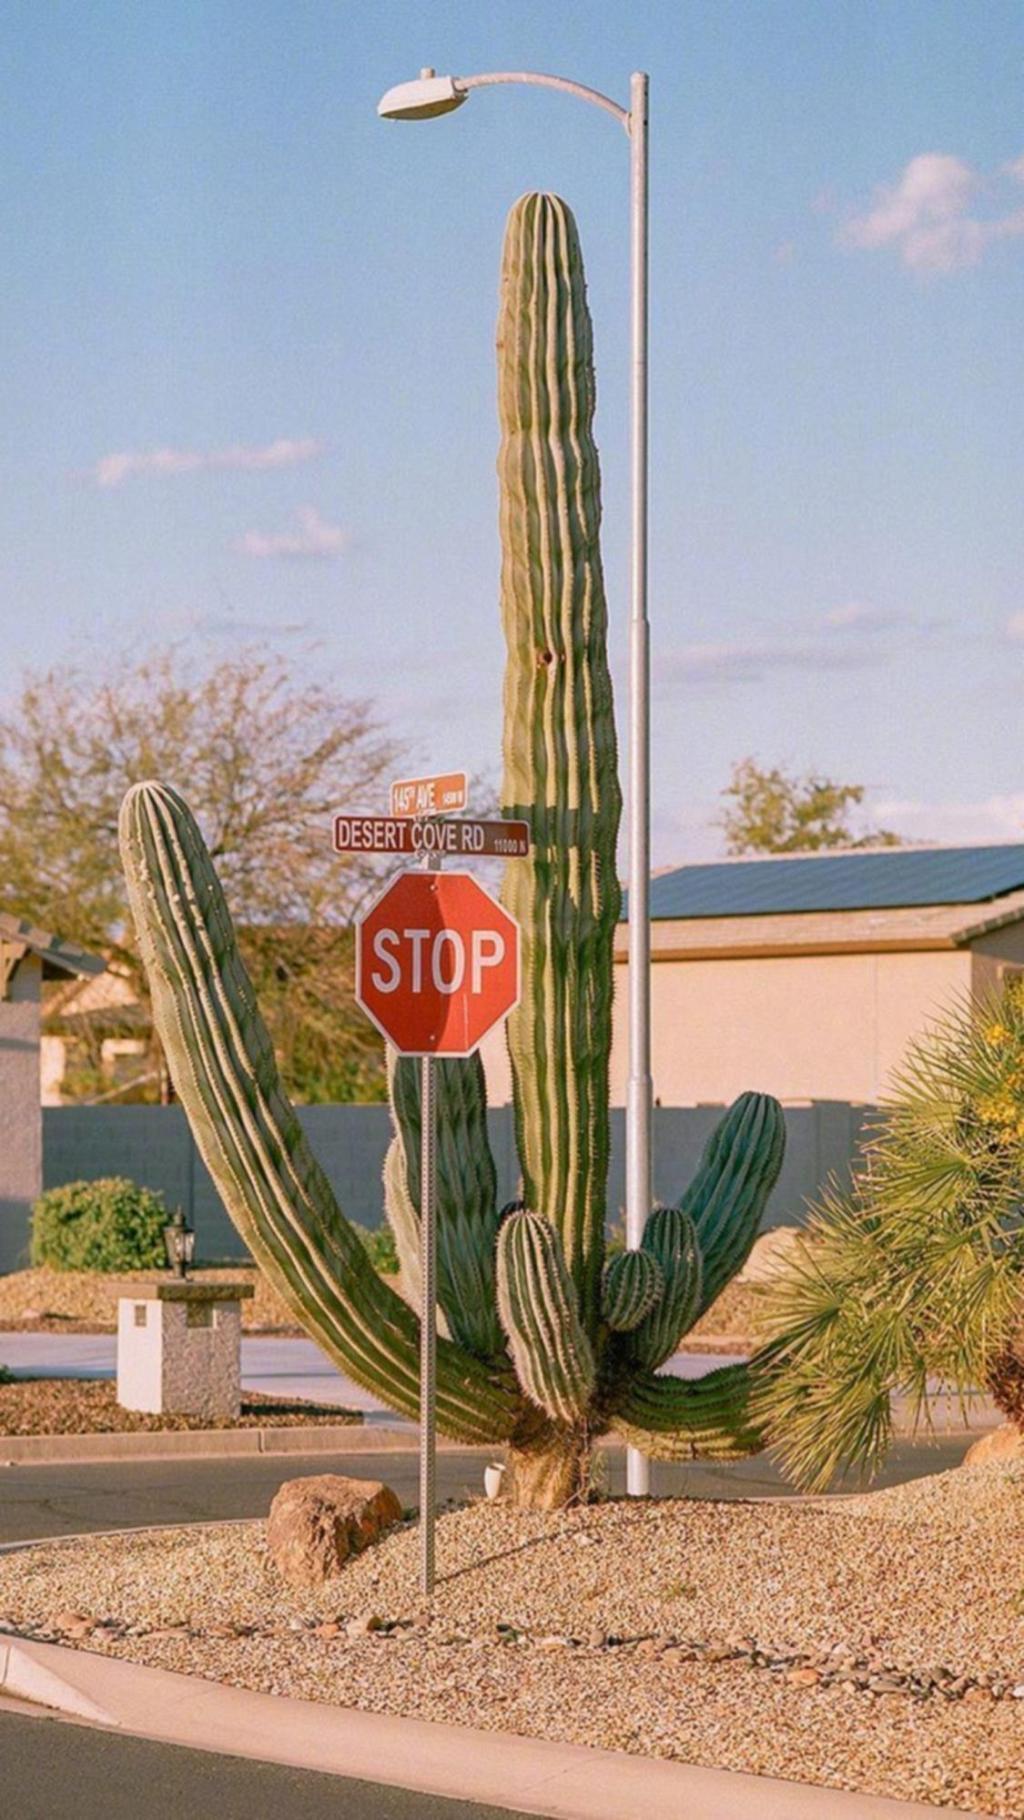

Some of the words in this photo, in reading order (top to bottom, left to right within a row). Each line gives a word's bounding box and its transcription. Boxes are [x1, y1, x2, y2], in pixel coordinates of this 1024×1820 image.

[416, 782, 435, 809] AVE
[338, 820, 407, 849] DESERT
[411, 822, 457, 850] COVE
[461, 824, 484, 851] RD
[494, 838, 518, 853] 11000
[371, 928, 506, 994] STOP
